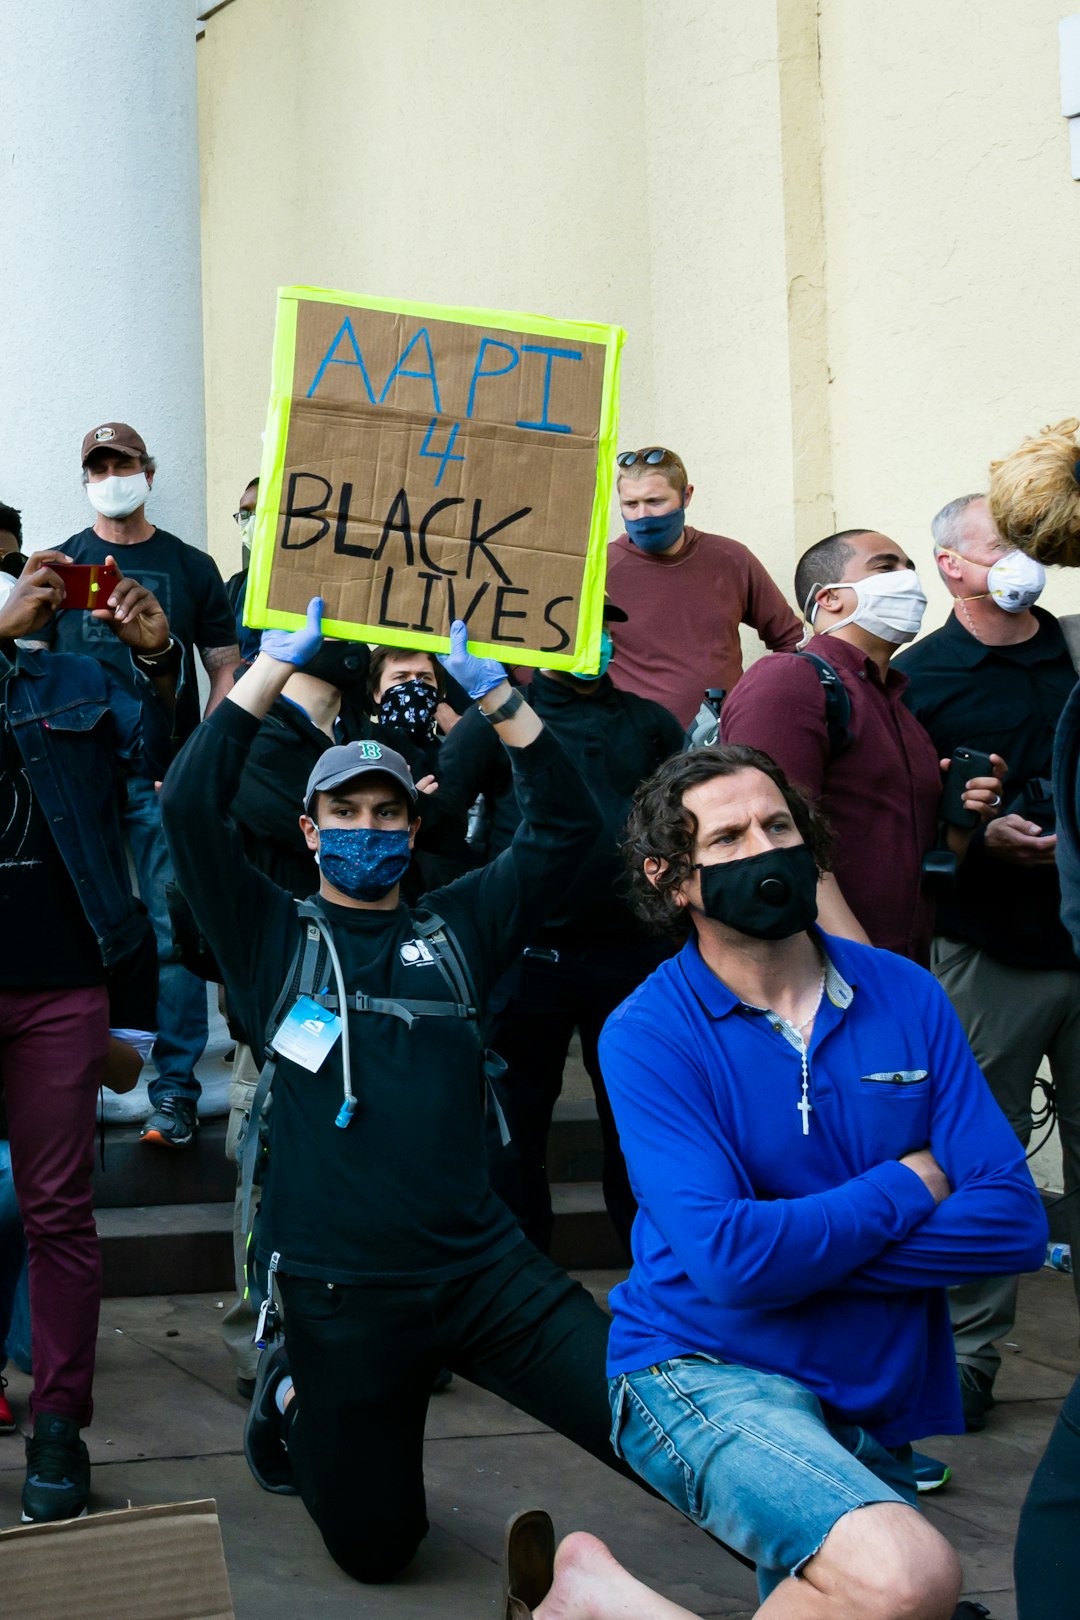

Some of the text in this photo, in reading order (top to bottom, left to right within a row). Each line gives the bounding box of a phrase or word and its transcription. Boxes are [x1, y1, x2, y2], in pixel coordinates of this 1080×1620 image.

[306, 316, 583, 434] AAPI
[418, 417, 467, 488] 4
[280, 472, 532, 585] BLACK
[378, 566, 574, 653] LIVES
[358, 742, 382, 760] B
